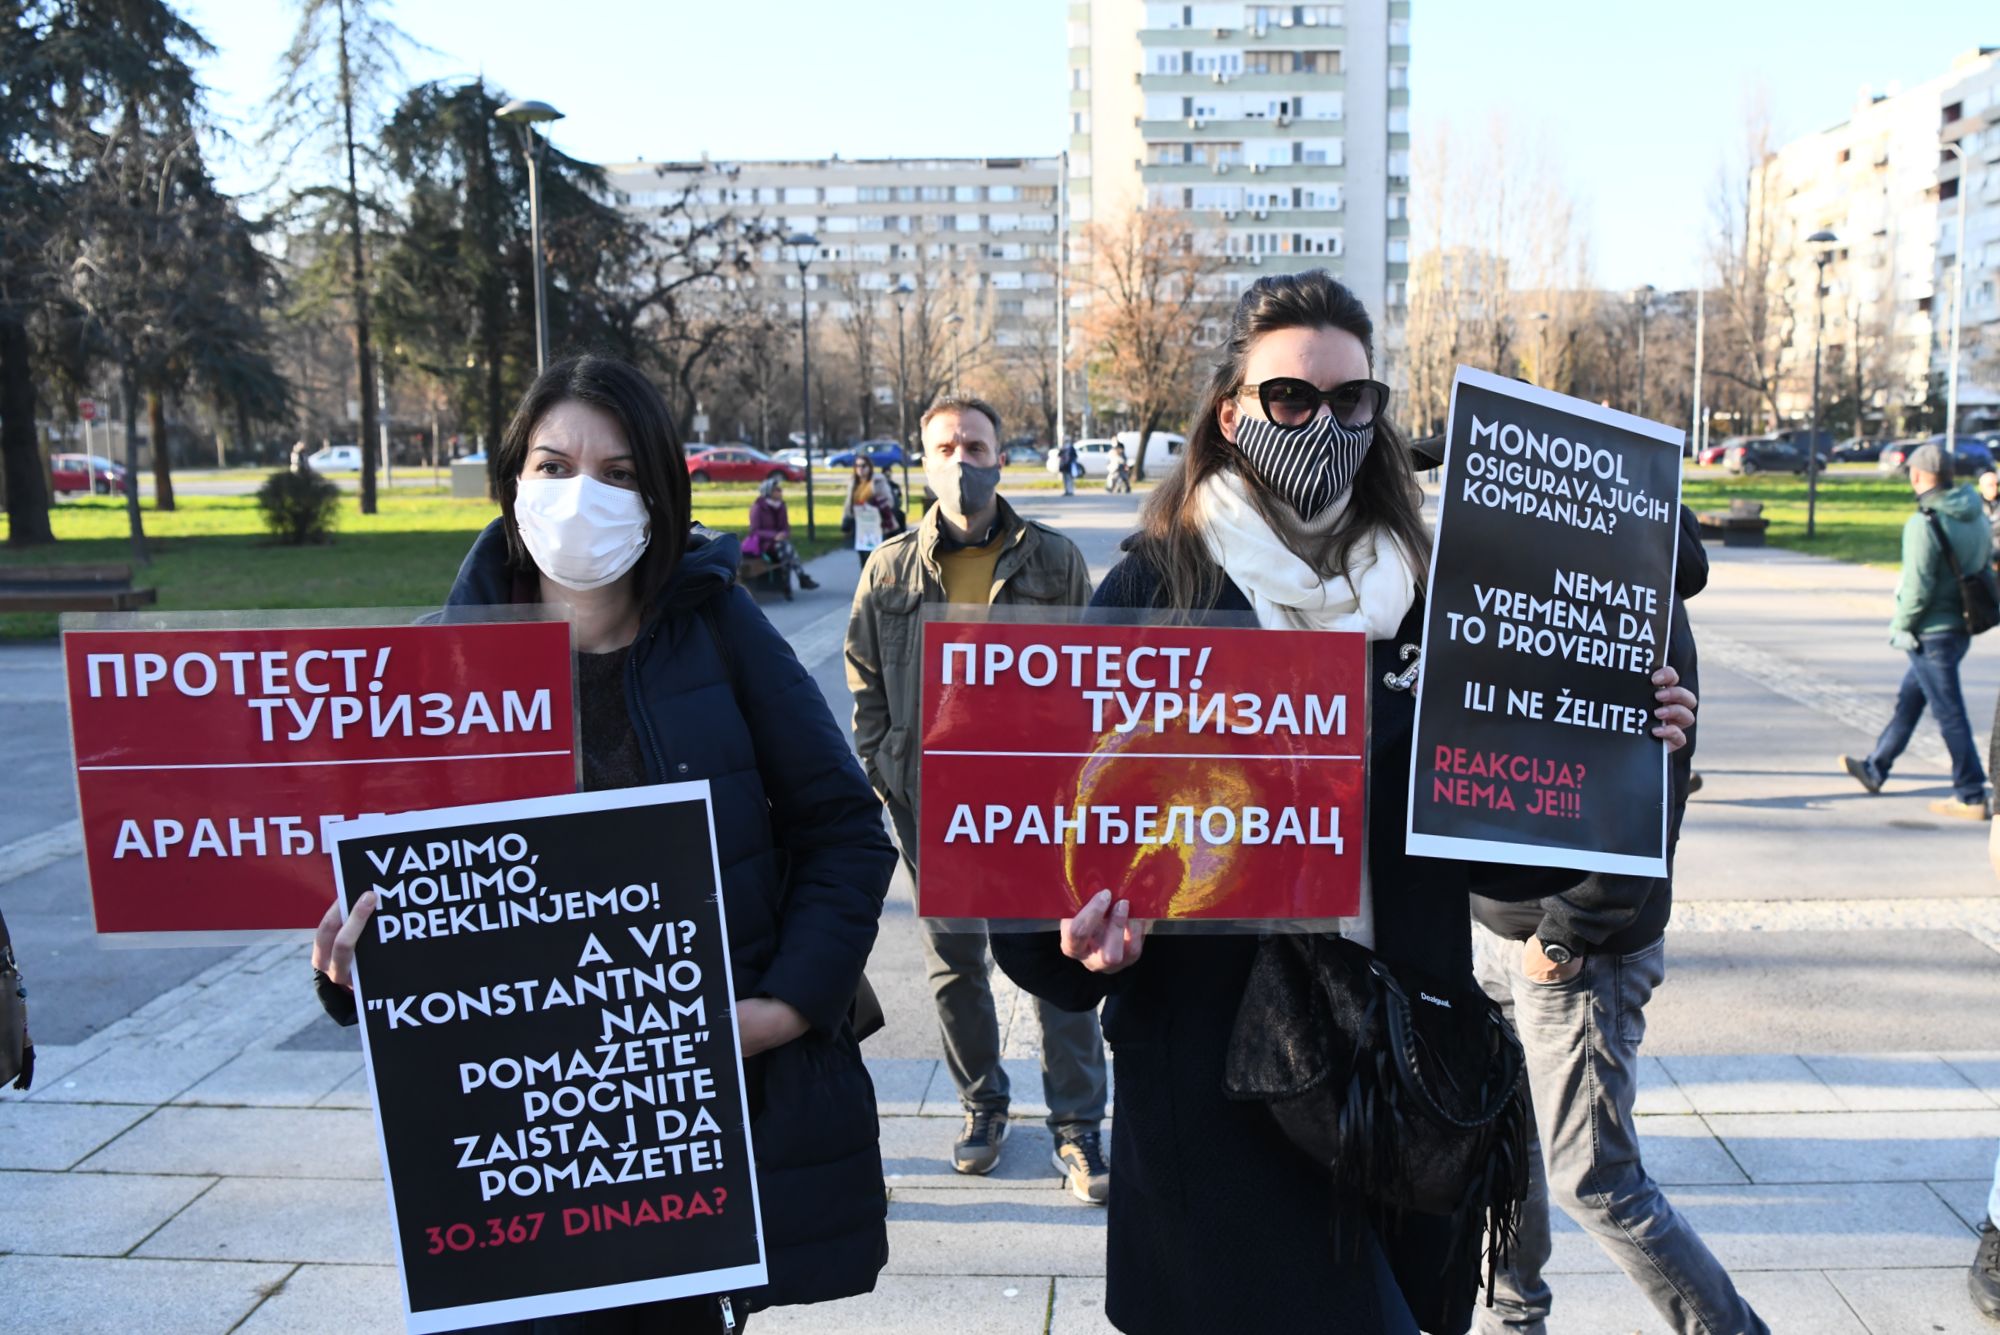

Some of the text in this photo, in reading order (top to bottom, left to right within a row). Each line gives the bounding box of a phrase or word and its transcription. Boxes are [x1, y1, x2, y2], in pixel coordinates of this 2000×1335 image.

[1469, 414, 1630, 486] MONOPOL
[1463, 478, 1618, 536] KOMPANIJA?
[1466, 452, 1670, 524] OSIGURAVAJUĆIH
[1473, 584, 1656, 646] VREMENA DA
[1553, 568, 1658, 616] NEMATE
[942, 643, 1213, 691] ПРОТЕСТ!
[1446, 612, 1655, 675] TO PROVERITE?
[87, 646, 391, 698] ПРОТЕСТ!
[247, 688, 552, 742] ТУРИЗАМ
[1082, 690, 1347, 736] ТУРИЗАМ
[1464, 680, 1649, 736] ILI NE ŽELITE?
[1434, 744, 1586, 790] REAKCIJA?
[1433, 777, 1582, 819] NEMA JE!!!
[365, 832, 539, 876] VAPIMO,
[943, 804, 1344, 855] АРАНЂЕЛОВАЦ
[373, 865, 548, 911] MOLIMO,
[377, 882, 661, 944] PREKLINJEMO!
[577, 919, 697, 968] A VI?
[367, 959, 702, 1030] "KONSTANTNO
[602, 995, 707, 1036] NAM
[459, 1031, 710, 1094] POMAŽETE"
[453, 1120, 611, 1169] ZAISTA
[655, 1105, 722, 1141] DA
[479, 1138, 724, 1202] POMAŽETE!
[426, 1186, 728, 1255] 30.367 DINARA?
